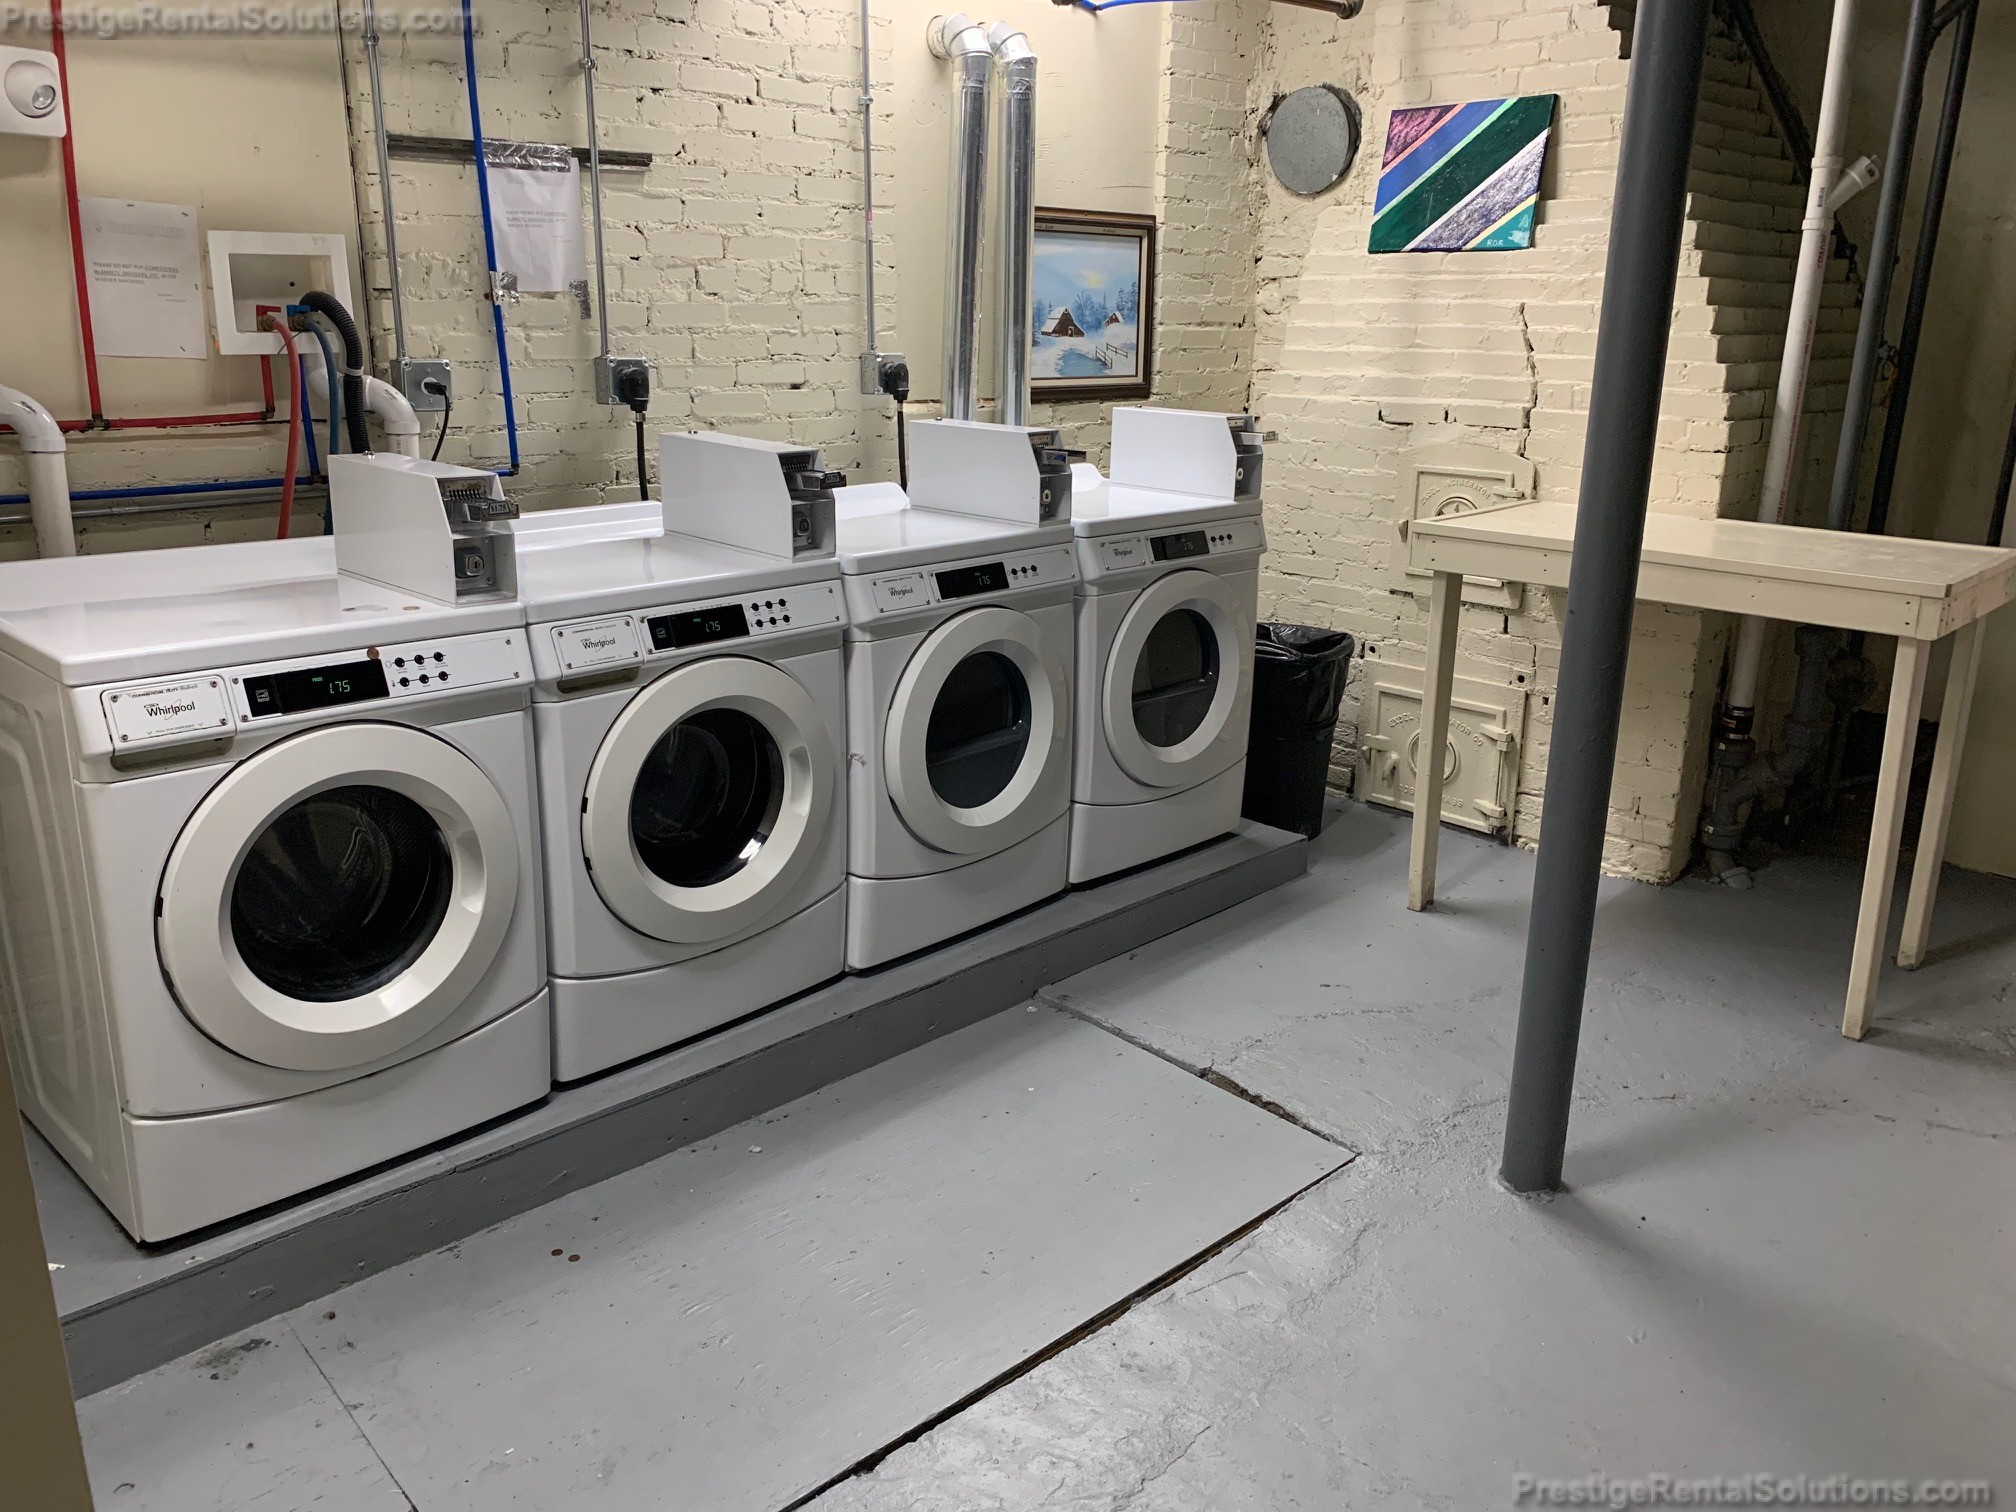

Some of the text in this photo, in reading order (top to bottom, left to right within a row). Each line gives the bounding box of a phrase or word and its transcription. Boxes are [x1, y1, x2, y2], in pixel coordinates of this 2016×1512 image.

[1420, 488, 1440, 506] EXCEL
[1443, 479, 1492, 499] INCINERATOR
[889, 587, 914, 598] Whirlpool
[582, 637, 616, 650] Whirlpool
[146, 701, 196, 717] Whirlpool
[1388, 712, 1414, 728] EXCEL
[1472, 733, 1484, 746] CO
